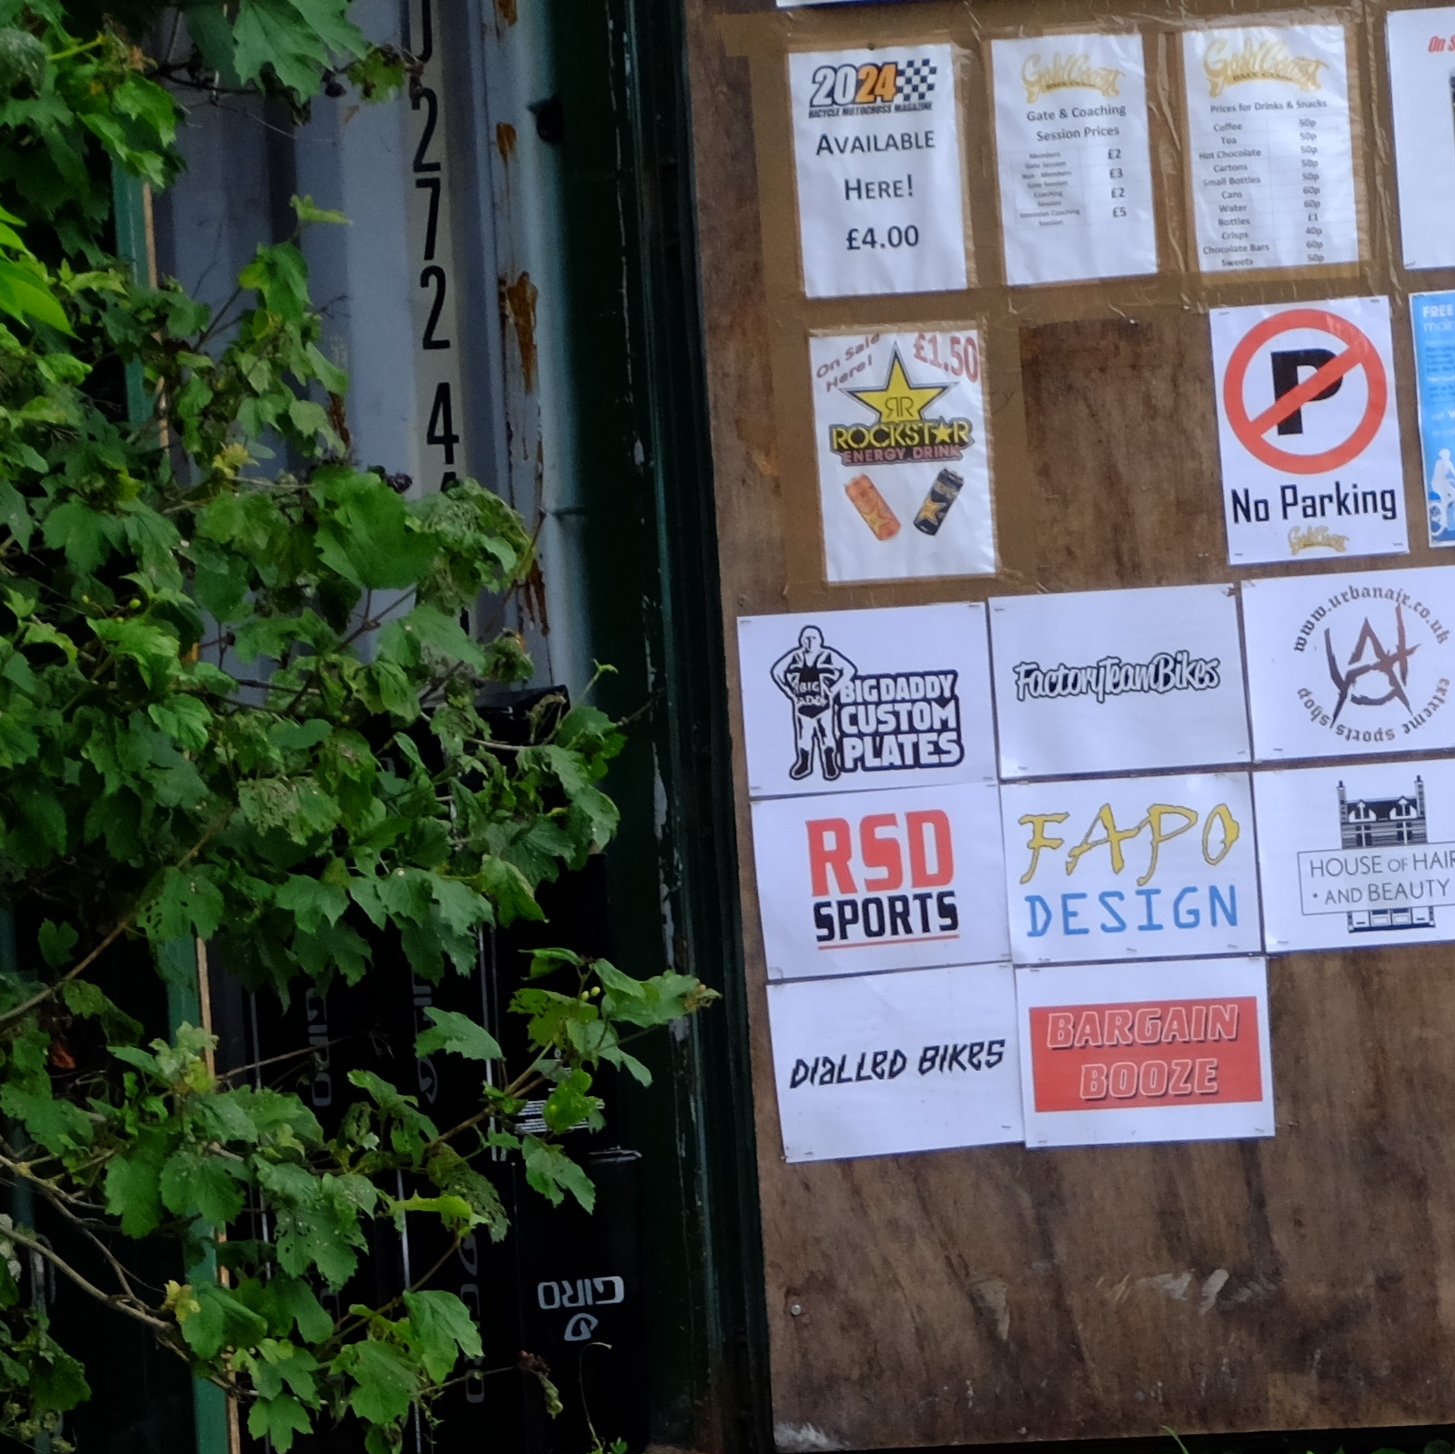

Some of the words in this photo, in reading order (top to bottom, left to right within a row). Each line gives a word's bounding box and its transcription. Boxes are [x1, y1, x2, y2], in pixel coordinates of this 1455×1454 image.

[1428, 35, 1446, 53] On
[809, 61, 899, 108] 2024
[1026, 111, 1056, 121] Gate
[1058, 108, 1068, 119] &
[1071, 105, 1127, 118] Coaching
[1210, 103, 1237, 114] Prices
[1239, 101, 1252, 111] for
[1254, 101, 1284, 111] Drinks
[1296, 99, 1328, 109] Snacks
[1036, 129, 1081, 142] Session
[1084, 125, 1120, 138] Prices
[1213, 123, 1243, 132] Coffee
[1299, 119, 1317, 129] 50p
[815, 130, 936, 156] AVAILABLE
[1220, 136, 1237, 145] Tea
[1107, 149, 1121, 160] £2
[1216, 149, 1262, 159] Chocolate
[1109, 168, 1124, 179] £3
[1213, 164, 1248, 173] Cartons
[844, 173, 914, 201] HERE!
[1229, 175, 1261, 184] Bottles
[1111, 187, 1125, 198] £2
[1221, 191, 1243, 199] Cans
[1112, 207, 1127, 218] £5
[1219, 204, 1248, 213] Water
[1218, 217, 1251, 226] Bottles
[846, 224, 920, 251] £4.00
[1221, 231, 1249, 241] Crisps
[1203, 244, 1248, 255] Chocolate
[1221, 258, 1254, 267] Sweets
[1423, 304, 1454, 318] FREE
[816, 358, 841, 379] On
[844, 333, 881, 362] Sale
[913, 331, 979, 384] £1.50
[826, 354, 873, 393] Here!
[843, 447, 907, 463] ENERGY
[912, 444, 961, 460] DRINK
[1231, 487, 1270, 524] No
[1280, 481, 1397, 521] Parking
[1293, 584, 1450, 653] www.urbanair.co.uk
[1403, 677, 1450, 735] extreme
[840, 700, 957, 734] CUSTOM
[842, 731, 961, 770] PLATES
[805, 809, 955, 897] RSD
[1018, 803, 1240, 887] FAPO
[1310, 855, 1383, 878] HOUSE
[1387, 857, 1409, 873] OF
[1324, 887, 1363, 905] AND
[1367, 878, 1450, 902] BEAUTY
[813, 890, 959, 943] SPORTS
[1024, 884, 1238, 937] DESIGN
[1047, 1004, 1239, 1050] BARGAIN
[1080, 1058, 1219, 1101] BOOZE
[537, 1275, 625, 1310] GIRO
